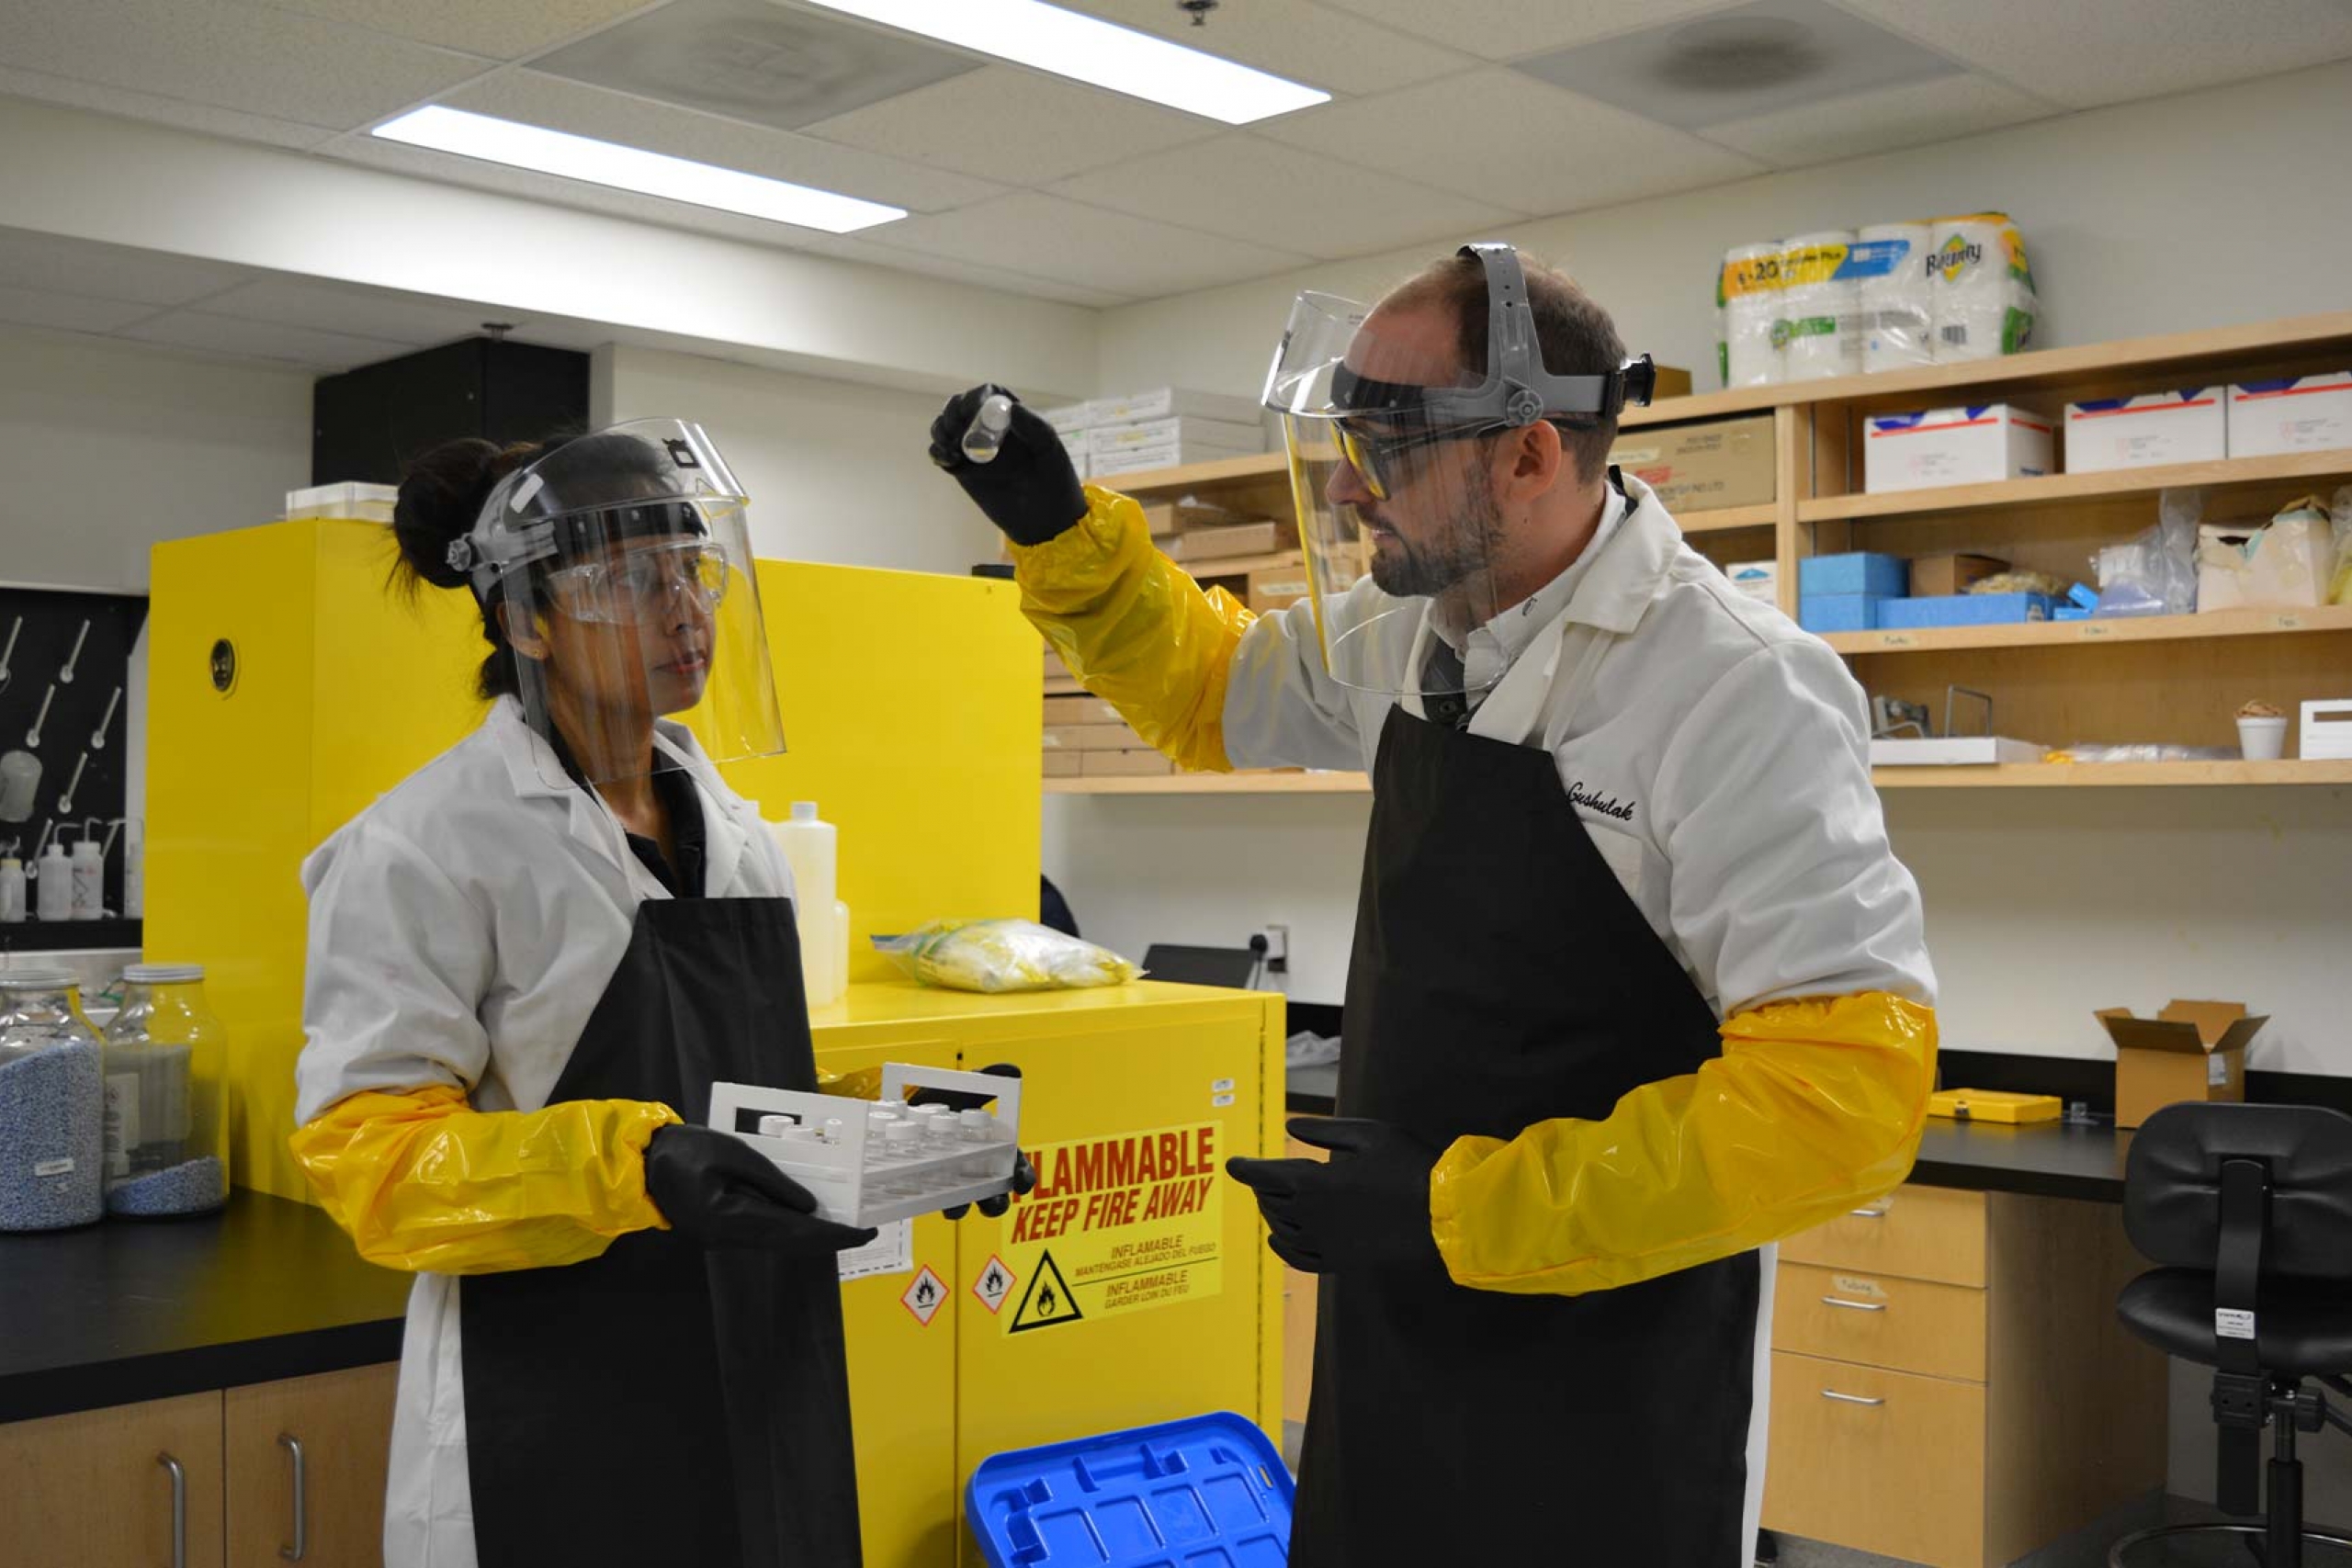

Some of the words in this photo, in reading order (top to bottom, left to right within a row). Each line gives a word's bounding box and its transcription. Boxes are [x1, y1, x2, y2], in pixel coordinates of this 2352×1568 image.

[1756, 260, 1780, 280] 20
[1926, 242, 1981, 276] Bounty
[1567, 781, 1635, 821] Gushulak
[1011, 1198, 1080, 1245] KEEP
[1082, 1188, 1142, 1232] FIRE
[1142, 1176, 1215, 1222] AWAY
[1111, 1235, 1184, 1259] INFLAMABLE
[1133, 1250, 1171, 1268] ALEJADO
[1171, 1247, 1188, 1259] DEL
[1188, 1242, 1216, 1256] FUEGO
[1106, 1269, 1188, 1297] INFLAMMABLE
[1104, 1292, 1139, 1309] GARDER
